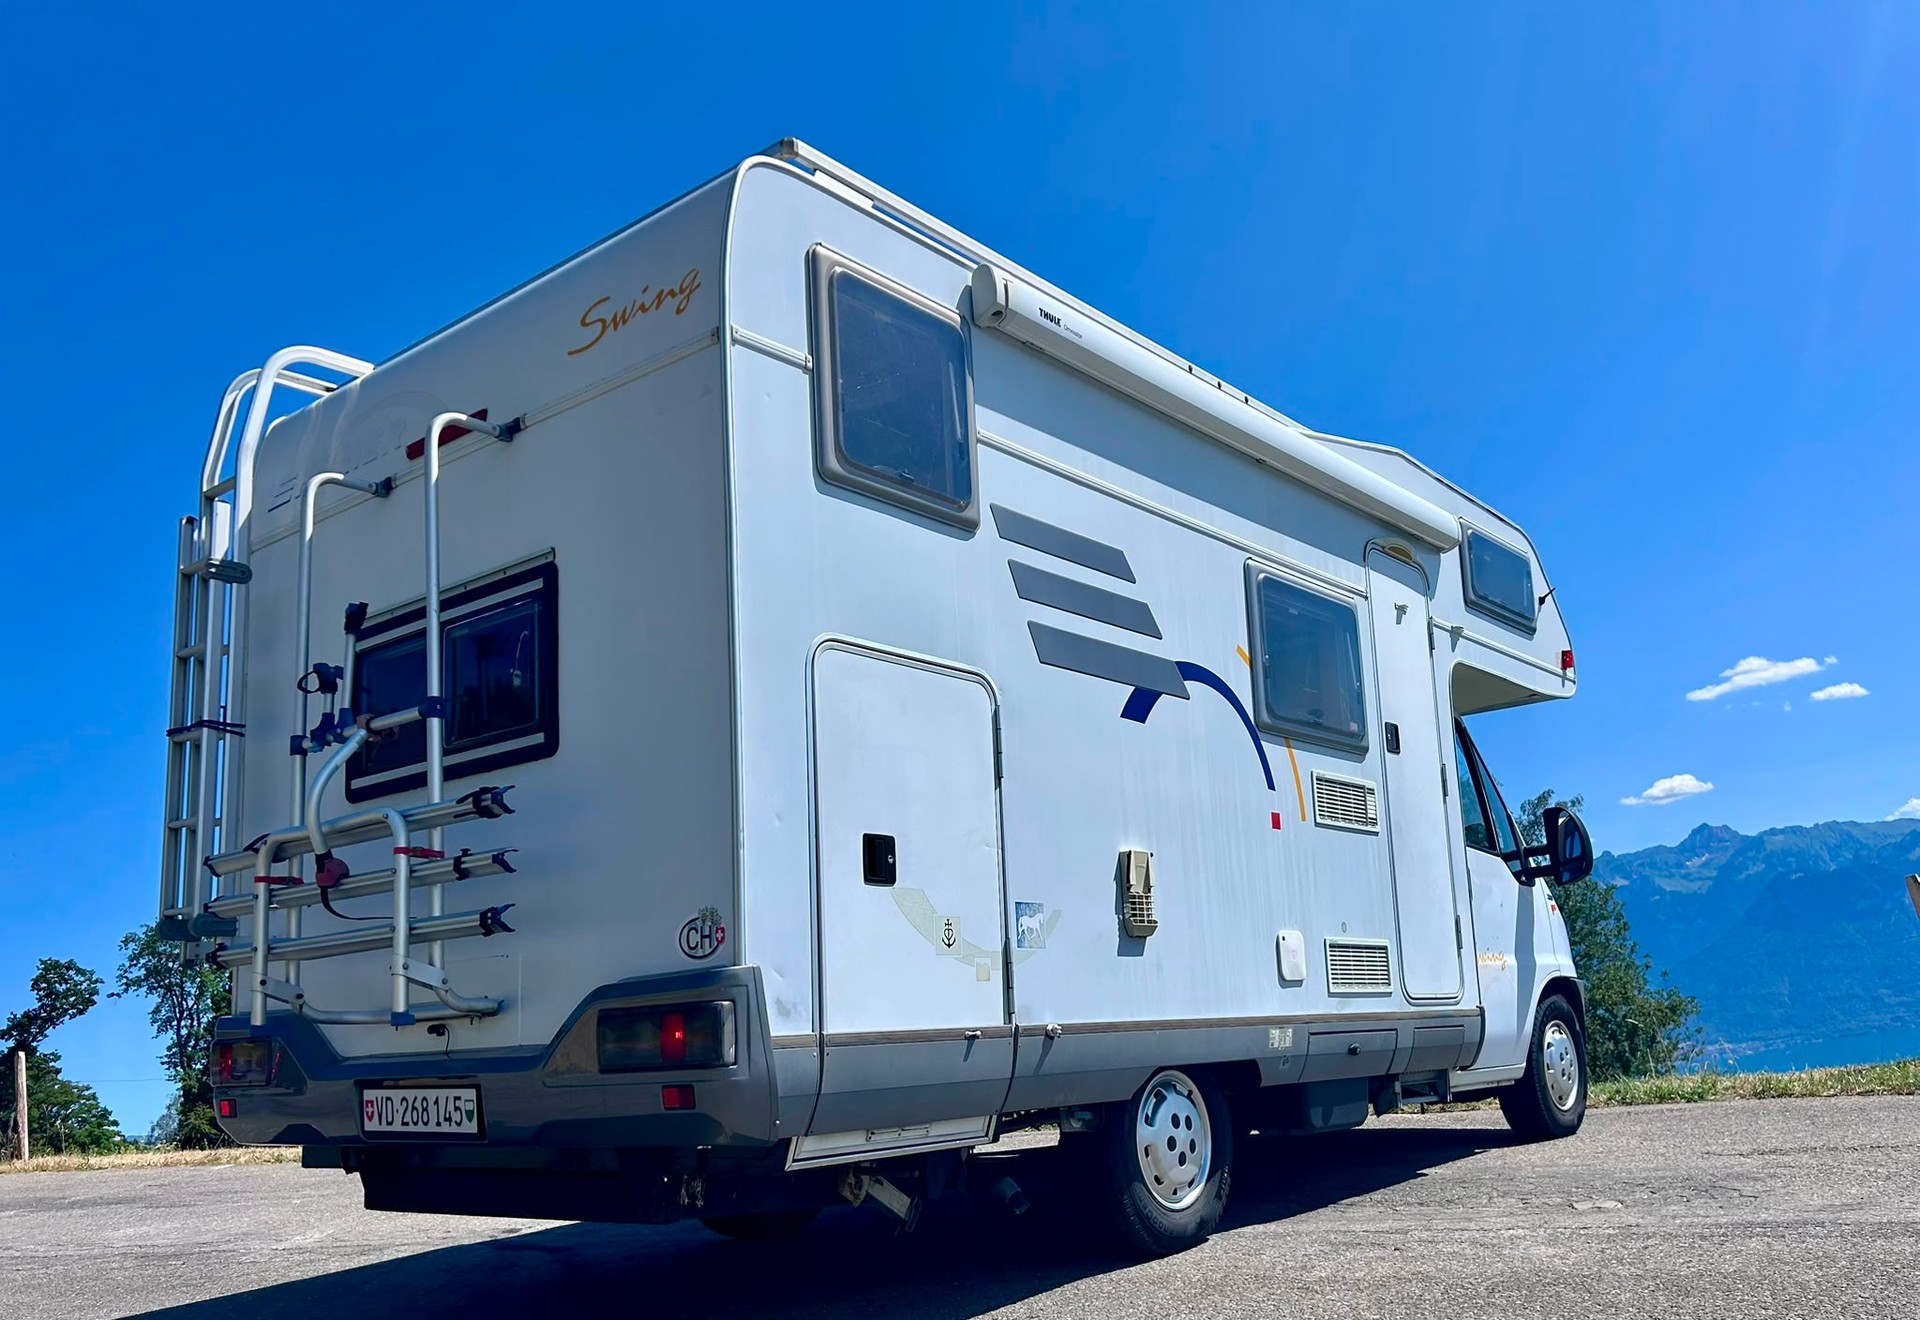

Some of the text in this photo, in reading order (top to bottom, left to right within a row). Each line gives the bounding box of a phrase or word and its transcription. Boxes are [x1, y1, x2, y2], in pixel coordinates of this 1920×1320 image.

[567, 268, 701, 356] Swing
[1038, 307, 1062, 328] THULE
[686, 925, 712, 951] CH
